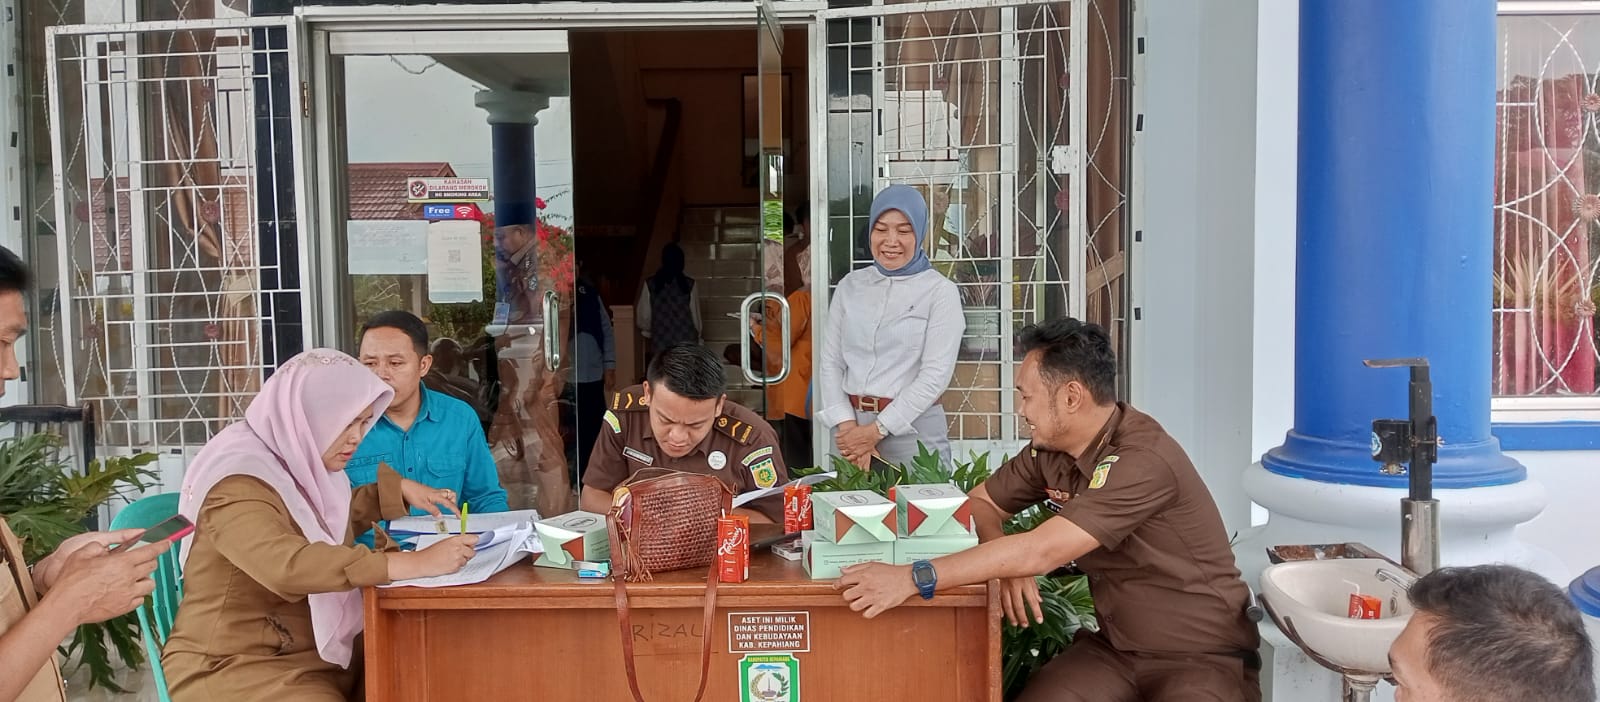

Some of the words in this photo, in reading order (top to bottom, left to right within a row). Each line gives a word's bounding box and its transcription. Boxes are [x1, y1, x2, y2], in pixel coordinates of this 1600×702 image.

[742, 616, 761, 624] ASET
[759, 624, 804, 632] PENDIDIKAN
[754, 632, 803, 640] KEBUDAYAAN
[739, 641, 756, 649] KAB.
[758, 640, 800, 648] KEPAHIANG
